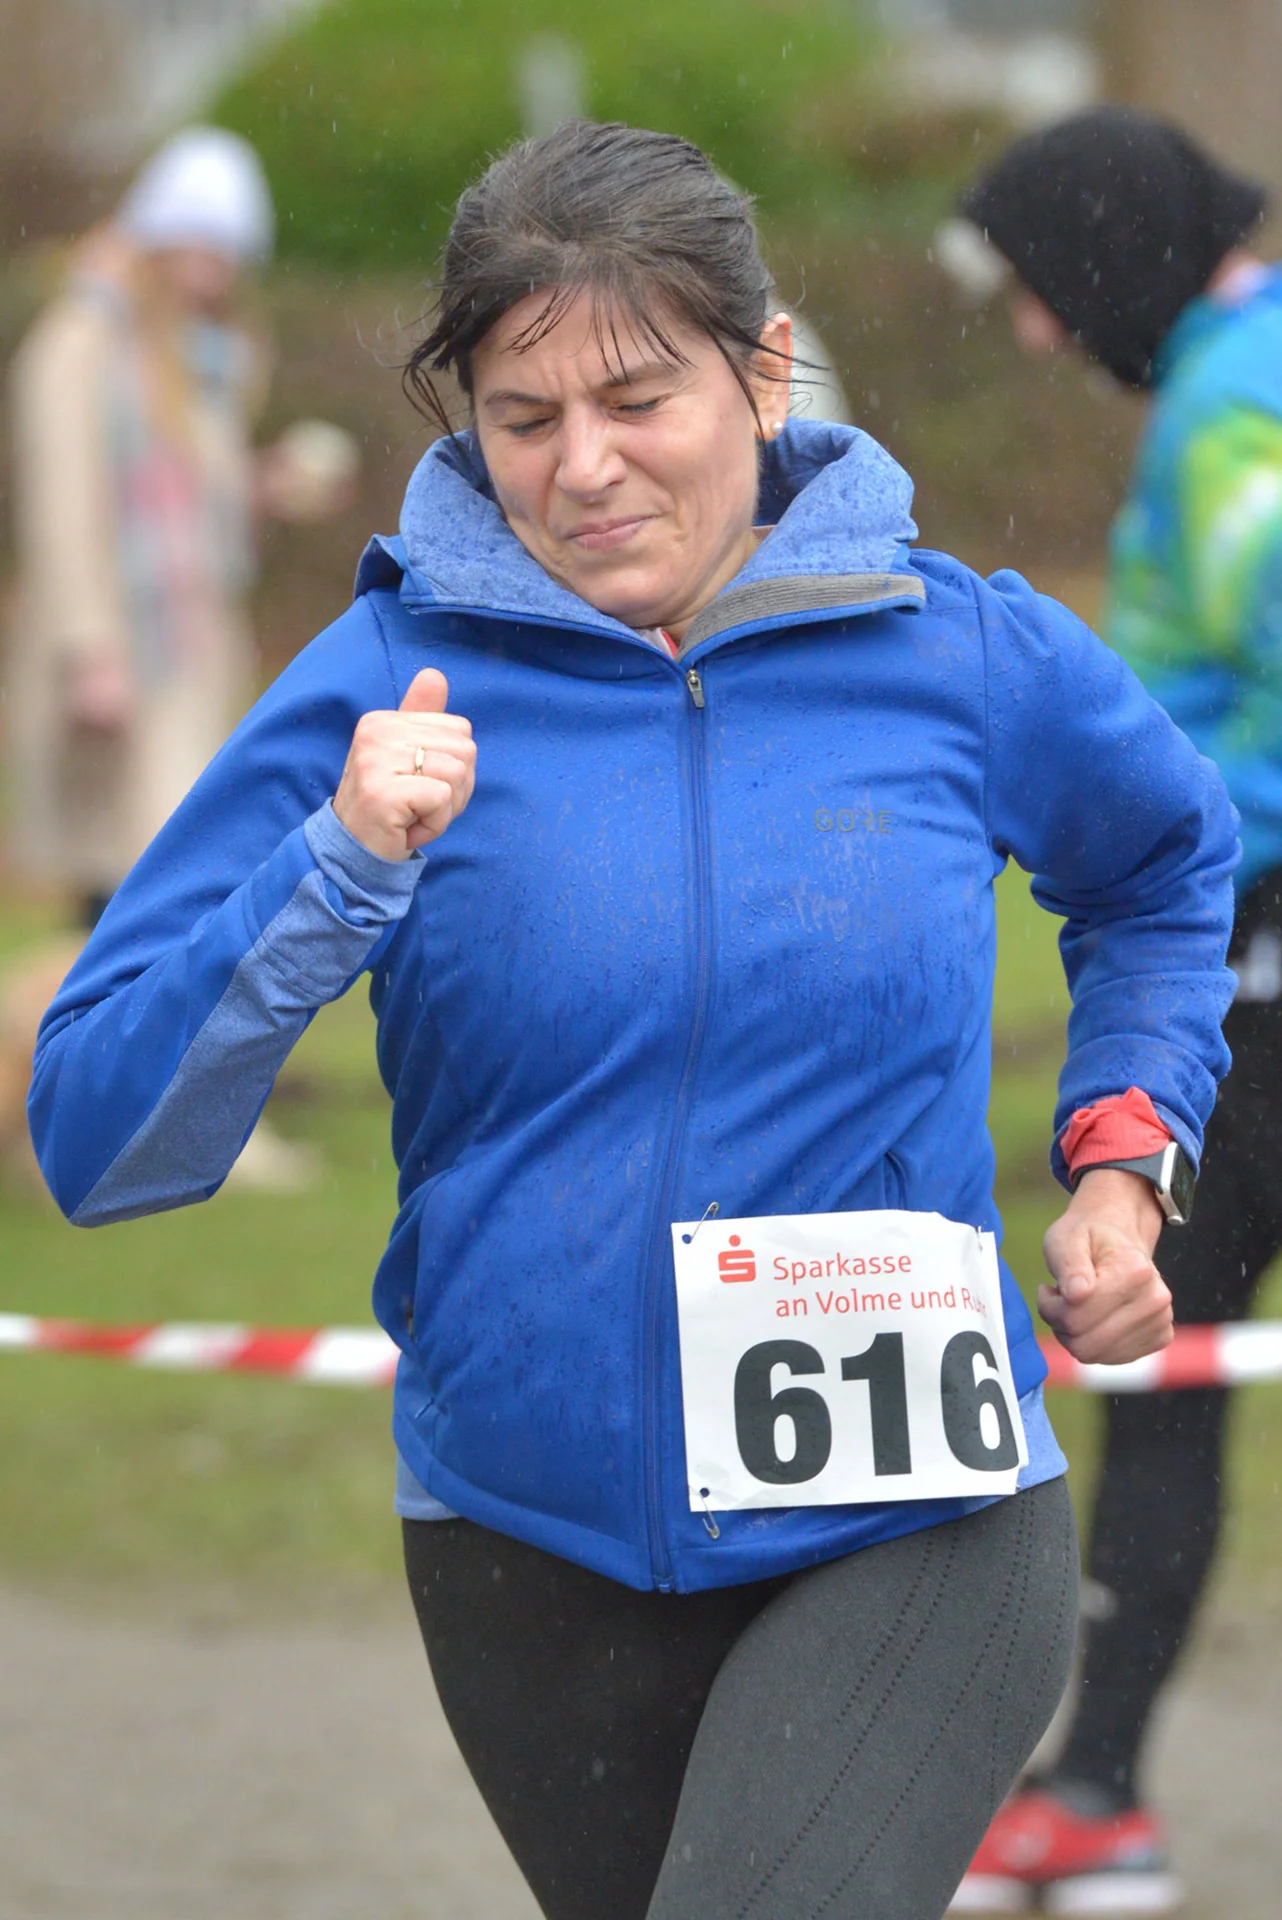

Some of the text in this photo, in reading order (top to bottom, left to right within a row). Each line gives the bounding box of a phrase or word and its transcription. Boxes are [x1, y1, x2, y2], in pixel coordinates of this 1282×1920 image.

[814, 808, 893, 834] GORE
[773, 1253, 912, 1285] Sparkasse
[776, 1298, 808, 1317] an
[815, 1288, 902, 1314] Volme
[911, 1286, 957, 1309] und
[734, 1330, 1020, 1485] 616
